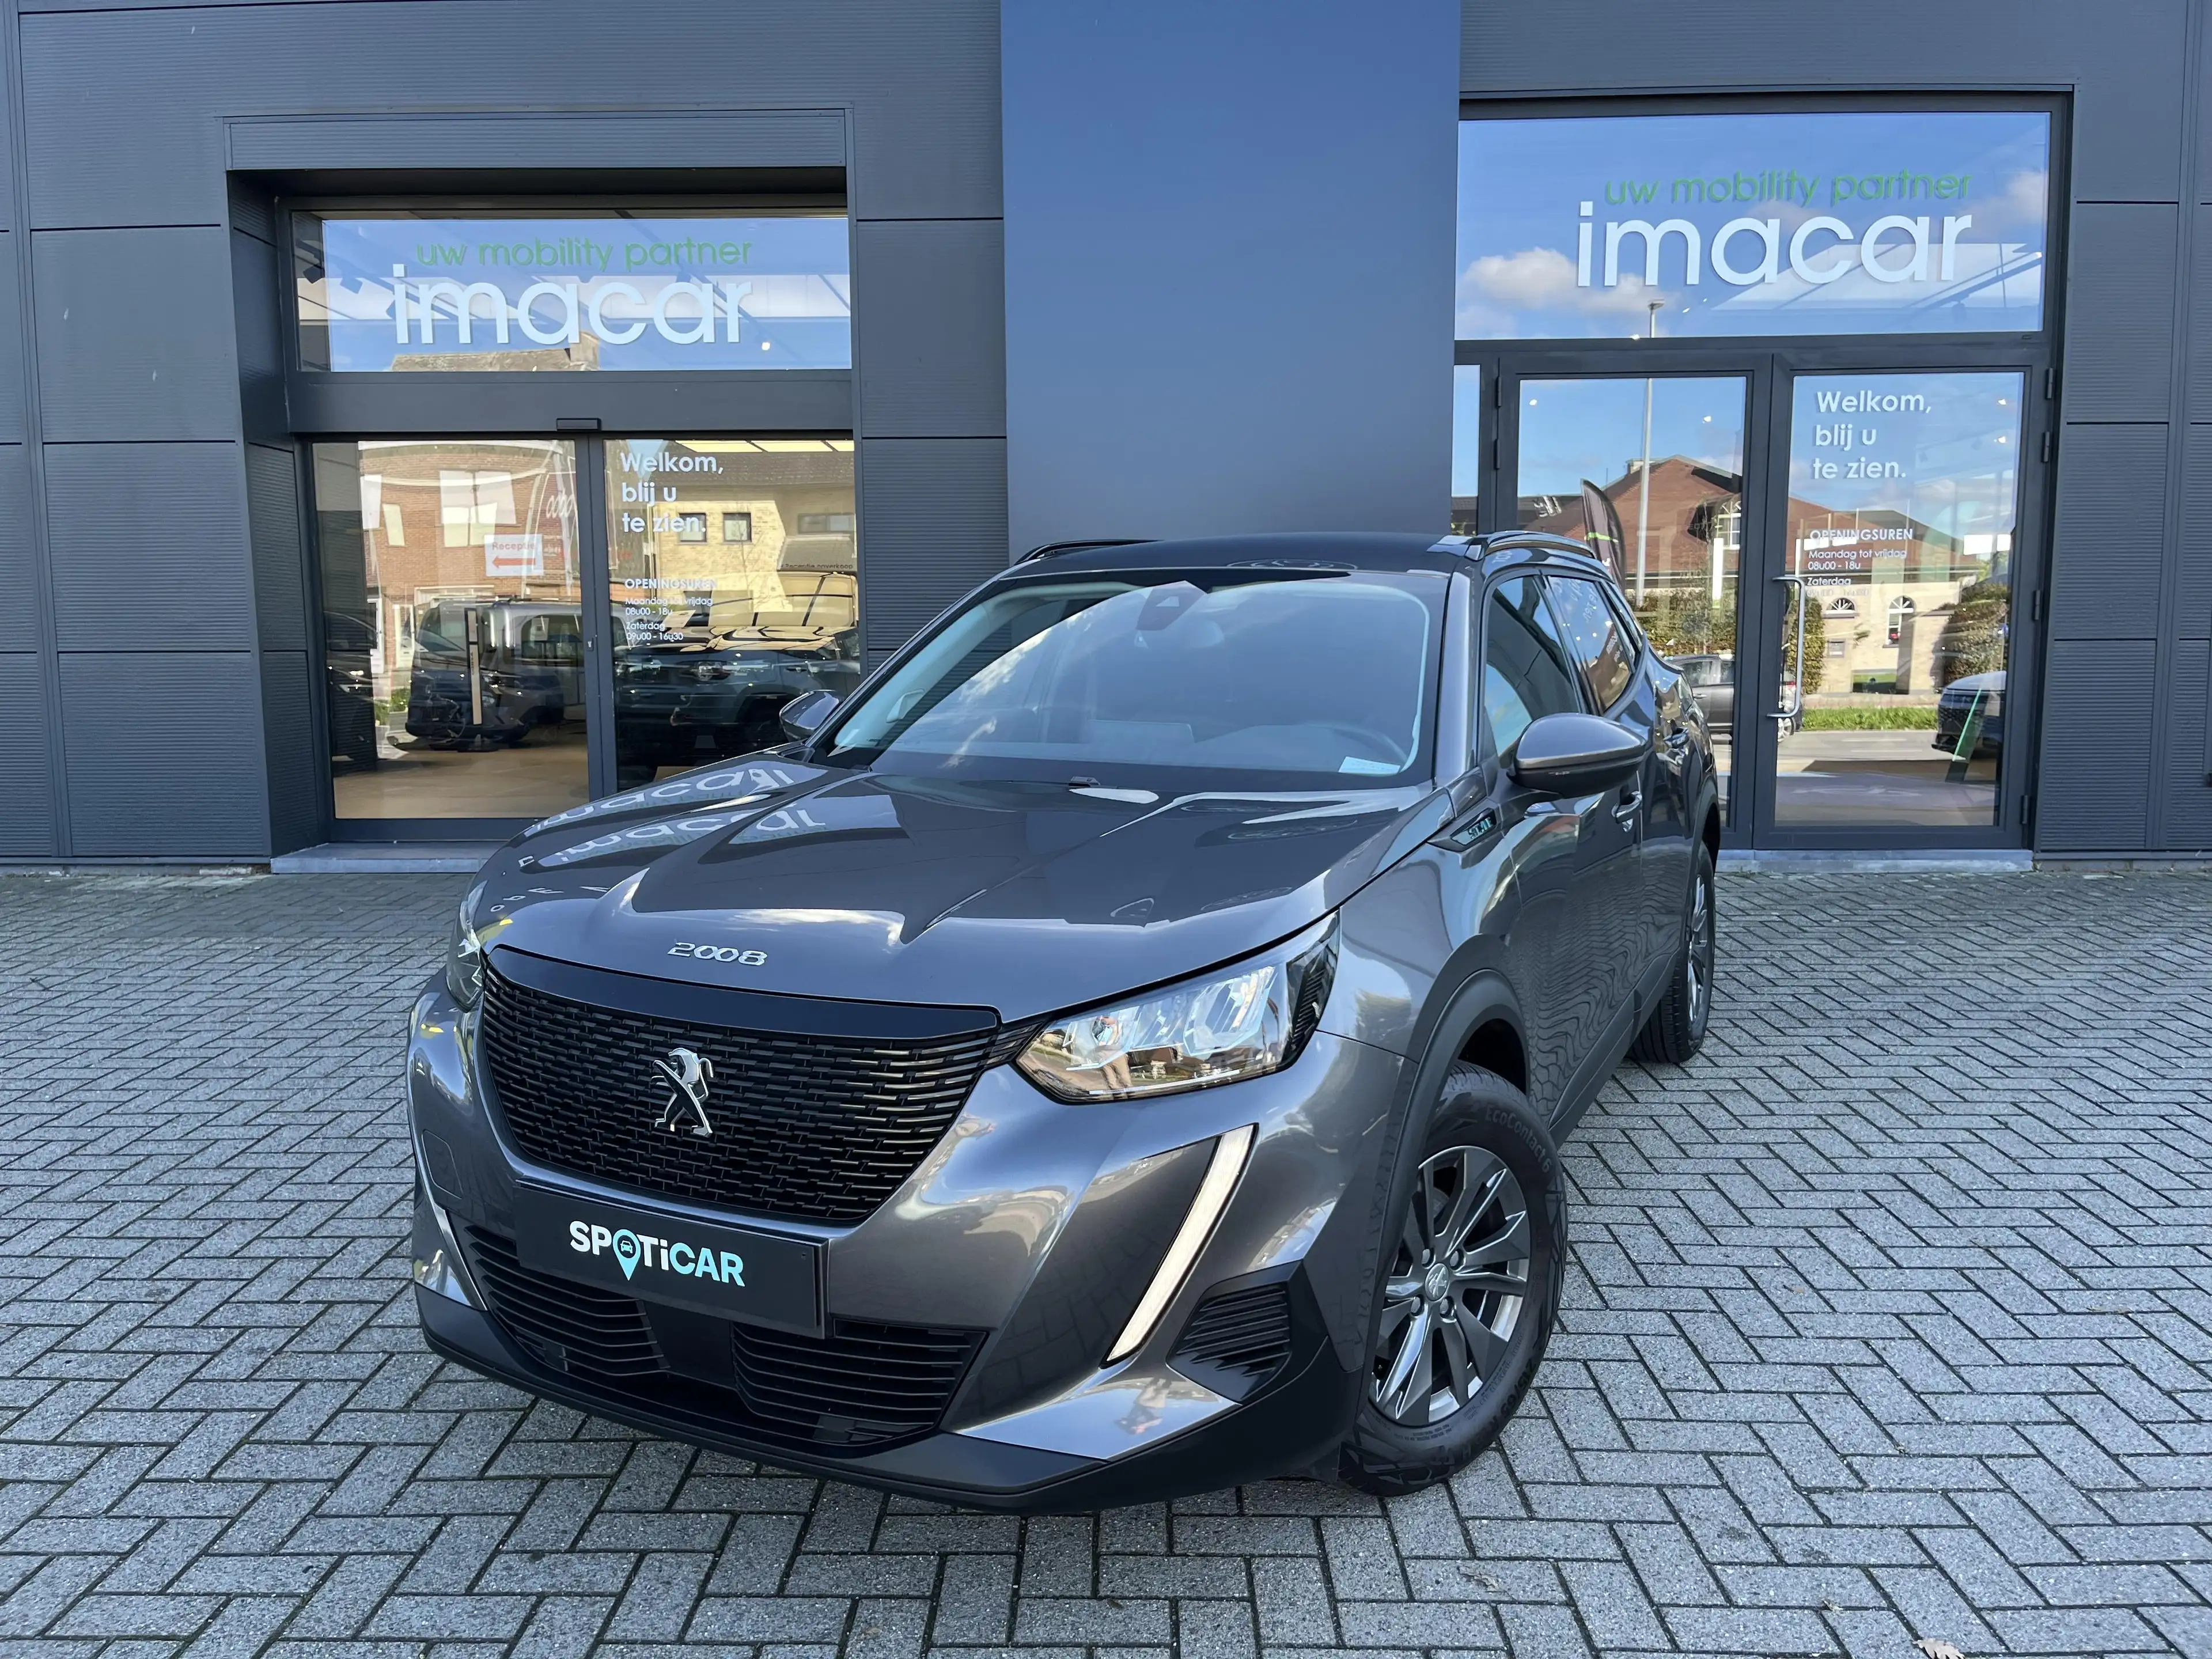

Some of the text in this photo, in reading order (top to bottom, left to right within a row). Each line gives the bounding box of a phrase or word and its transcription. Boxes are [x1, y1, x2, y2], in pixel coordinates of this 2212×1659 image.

[1605, 168, 1974, 208] uw mobility partner
[416, 236, 752, 273] uw mobility partner
[1577, 200, 1973, 287] imacar
[392, 263, 752, 345] imacar
[1817, 389, 1931, 414] Welkom,
[1815, 423, 1877, 452] blij u
[620, 451, 724, 475] Welkom,
[1813, 456, 1906, 479] te zien.
[622, 482, 677, 507] blij u
[622, 512, 706, 533] te zien.
[1809, 528, 1913, 540] OPENINGSUREN
[1808, 548, 1907, 560] Maandag tot vrijdag
[1808, 560, 1836, 570] 08u00
[1844, 560, 1861, 570] 18u
[624, 578, 717, 589] OPENINGSUREN
[1806, 577, 1852, 586] Zaterdag
[625, 597, 668, 607] Maandag
[685, 597, 713, 607] vrijdag
[625, 607, 651, 616] 08u00
[658, 607, 673, 616] 18u
[626, 622, 666, 631] Zaterdag
[626, 632, 652, 641] 09u00
[659, 632, 684, 641] 16u30
[667, 941, 768, 966] 2008
[1484, 1105, 1552, 1173] EcoContact 6
